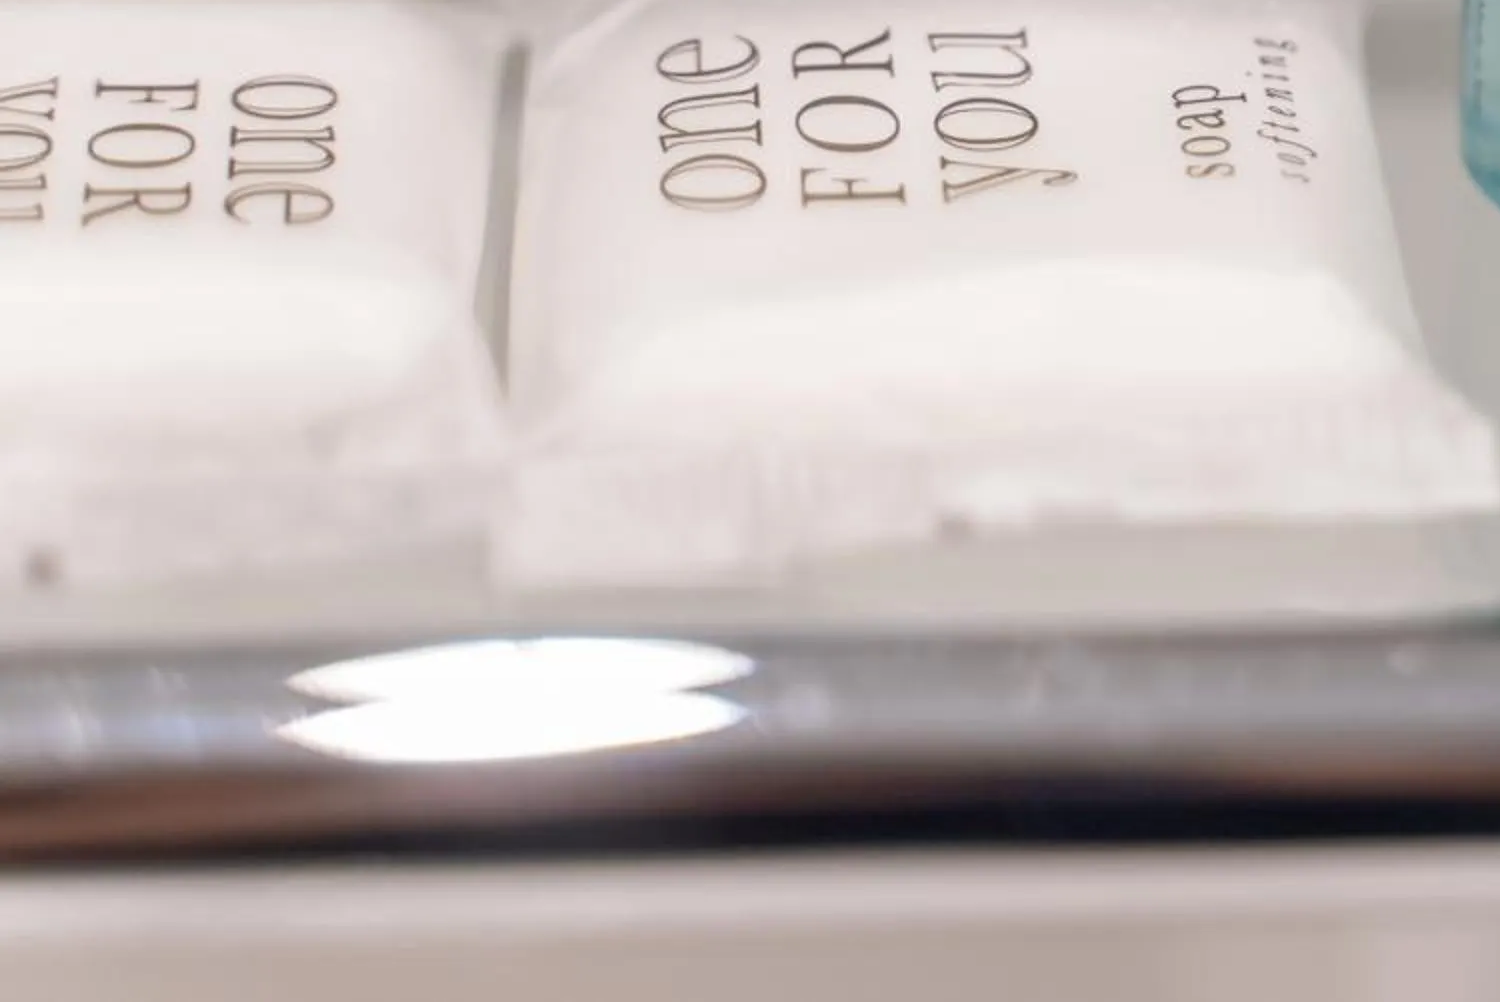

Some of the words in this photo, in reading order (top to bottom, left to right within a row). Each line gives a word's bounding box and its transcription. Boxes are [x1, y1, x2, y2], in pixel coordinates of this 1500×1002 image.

[79, 78, 200, 227] FOR
[223, 73, 339, 226] one
[655, 34, 768, 212] one
[791, 27, 907, 207] FOR
[927, 26, 1079, 205] you
[1170, 83, 1248, 181] soap
[1245, 36, 1318, 185] softening
